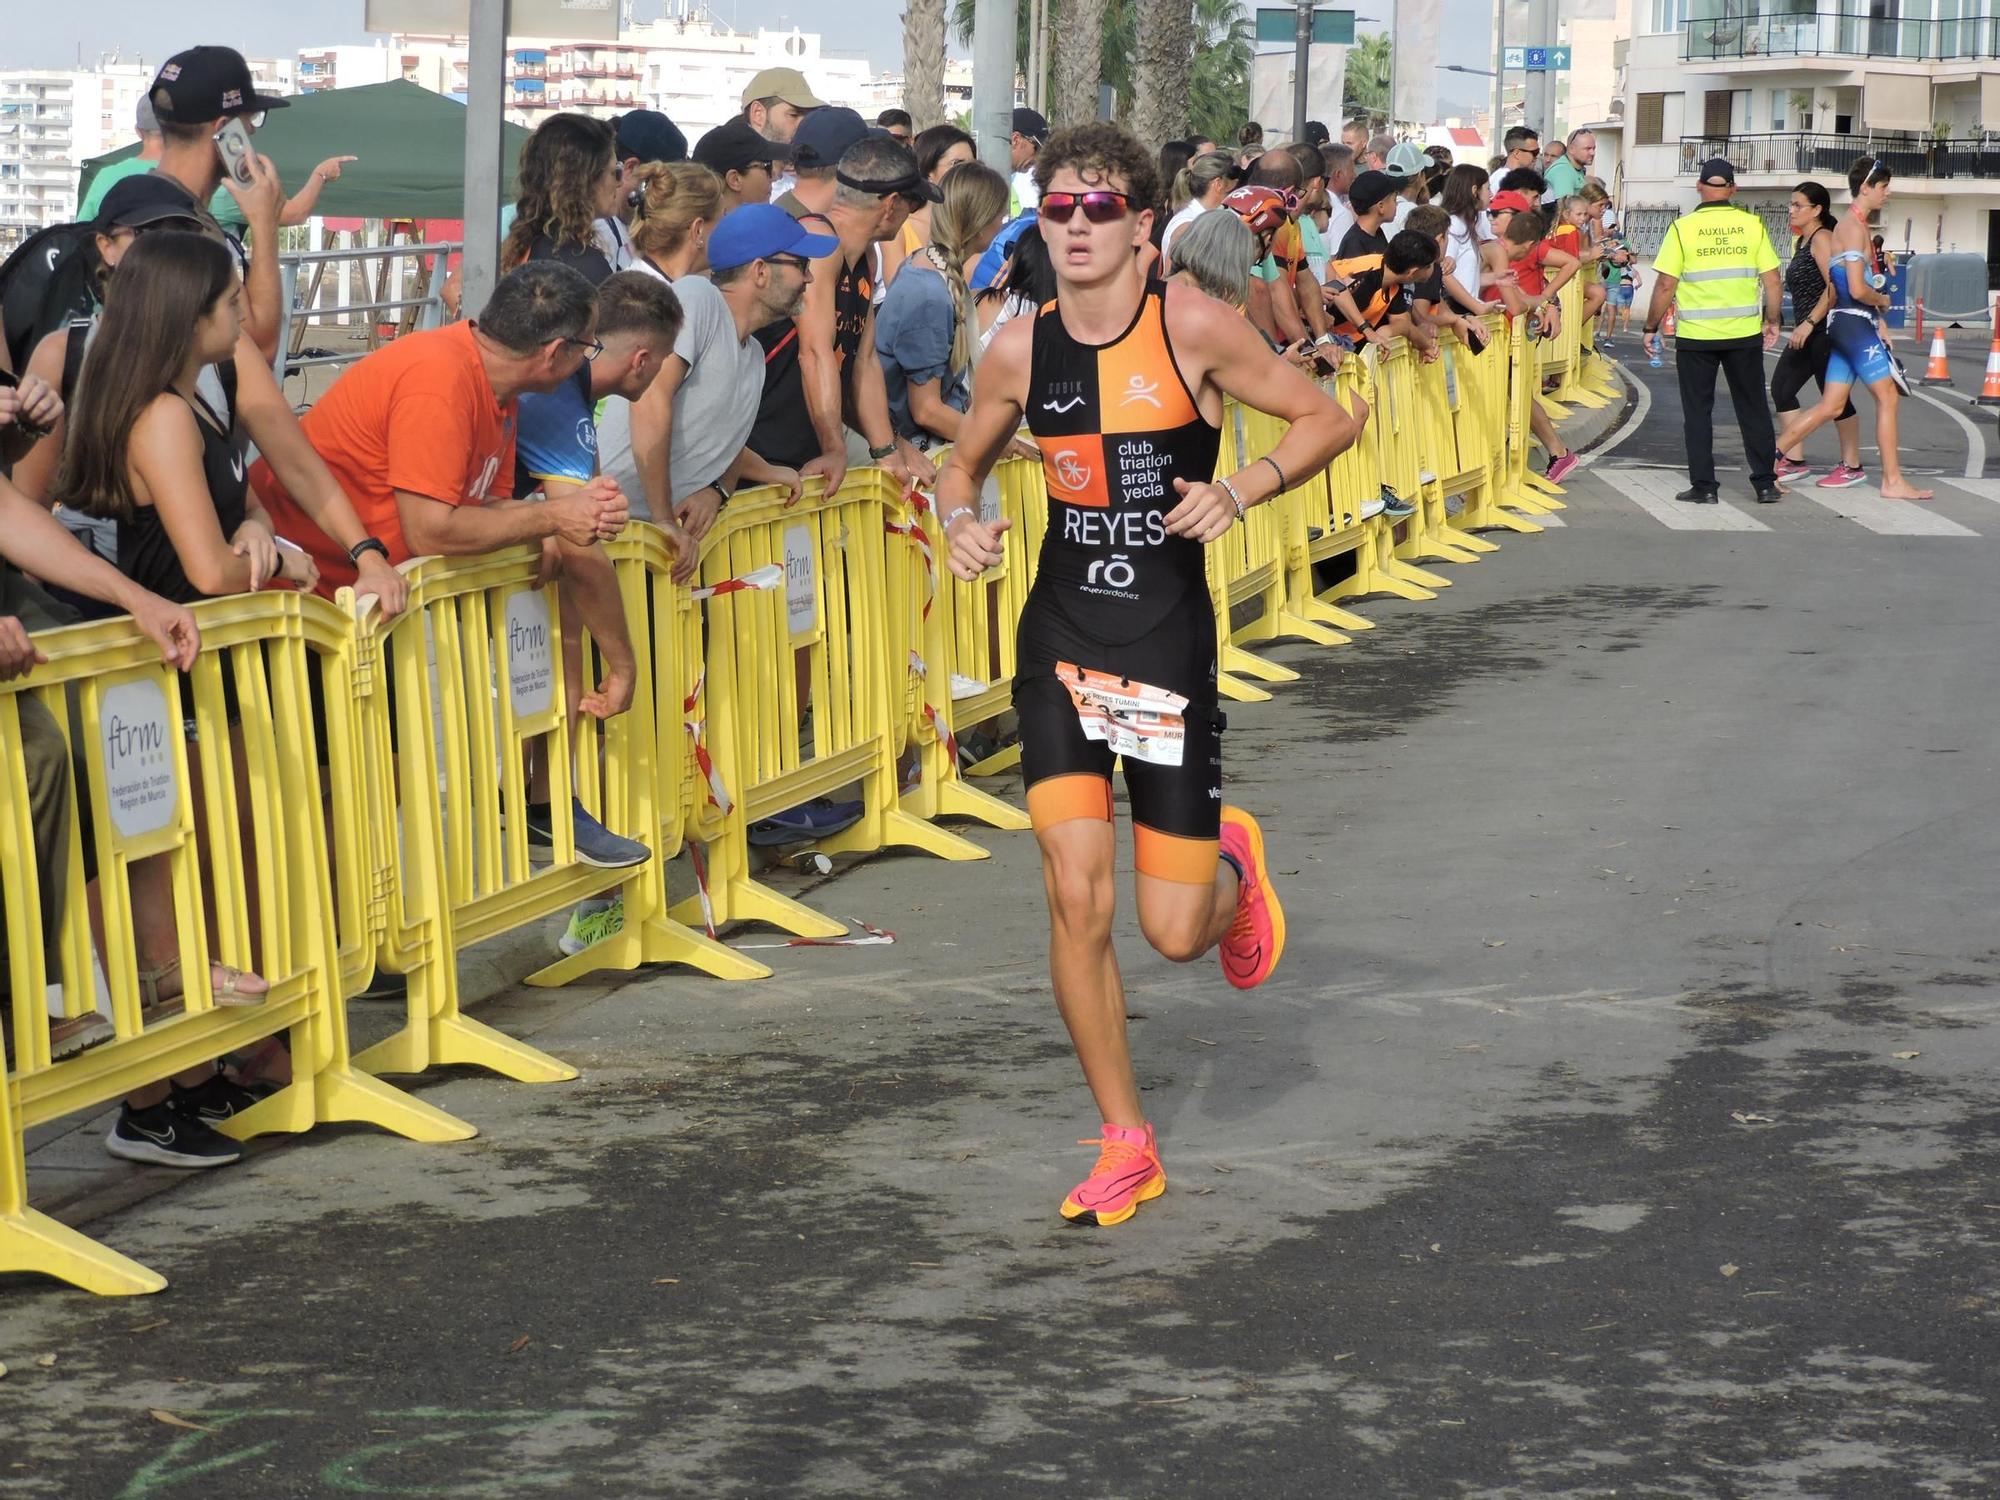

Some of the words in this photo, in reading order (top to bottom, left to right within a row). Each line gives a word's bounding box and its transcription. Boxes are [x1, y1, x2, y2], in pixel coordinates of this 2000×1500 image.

[1698, 227, 1744, 236] AUXILIAR
[1715, 237, 1729, 245] DE
[1696, 246, 1748, 257] SERVICIOS
[1118, 440, 1153, 455] club
[1119, 453, 1172, 470] triatlón
[1121, 468, 1161, 485] arabí
[1122, 483, 1164, 503] yecla
[1064, 508, 1165, 546] REYES
[786, 549, 811, 588] ftrm
[509, 617, 546, 662] ftrm
[1093, 693, 1113, 703] REYES
[108, 715, 164, 770] ftrm
[1163, 731, 1183, 741] MUR
